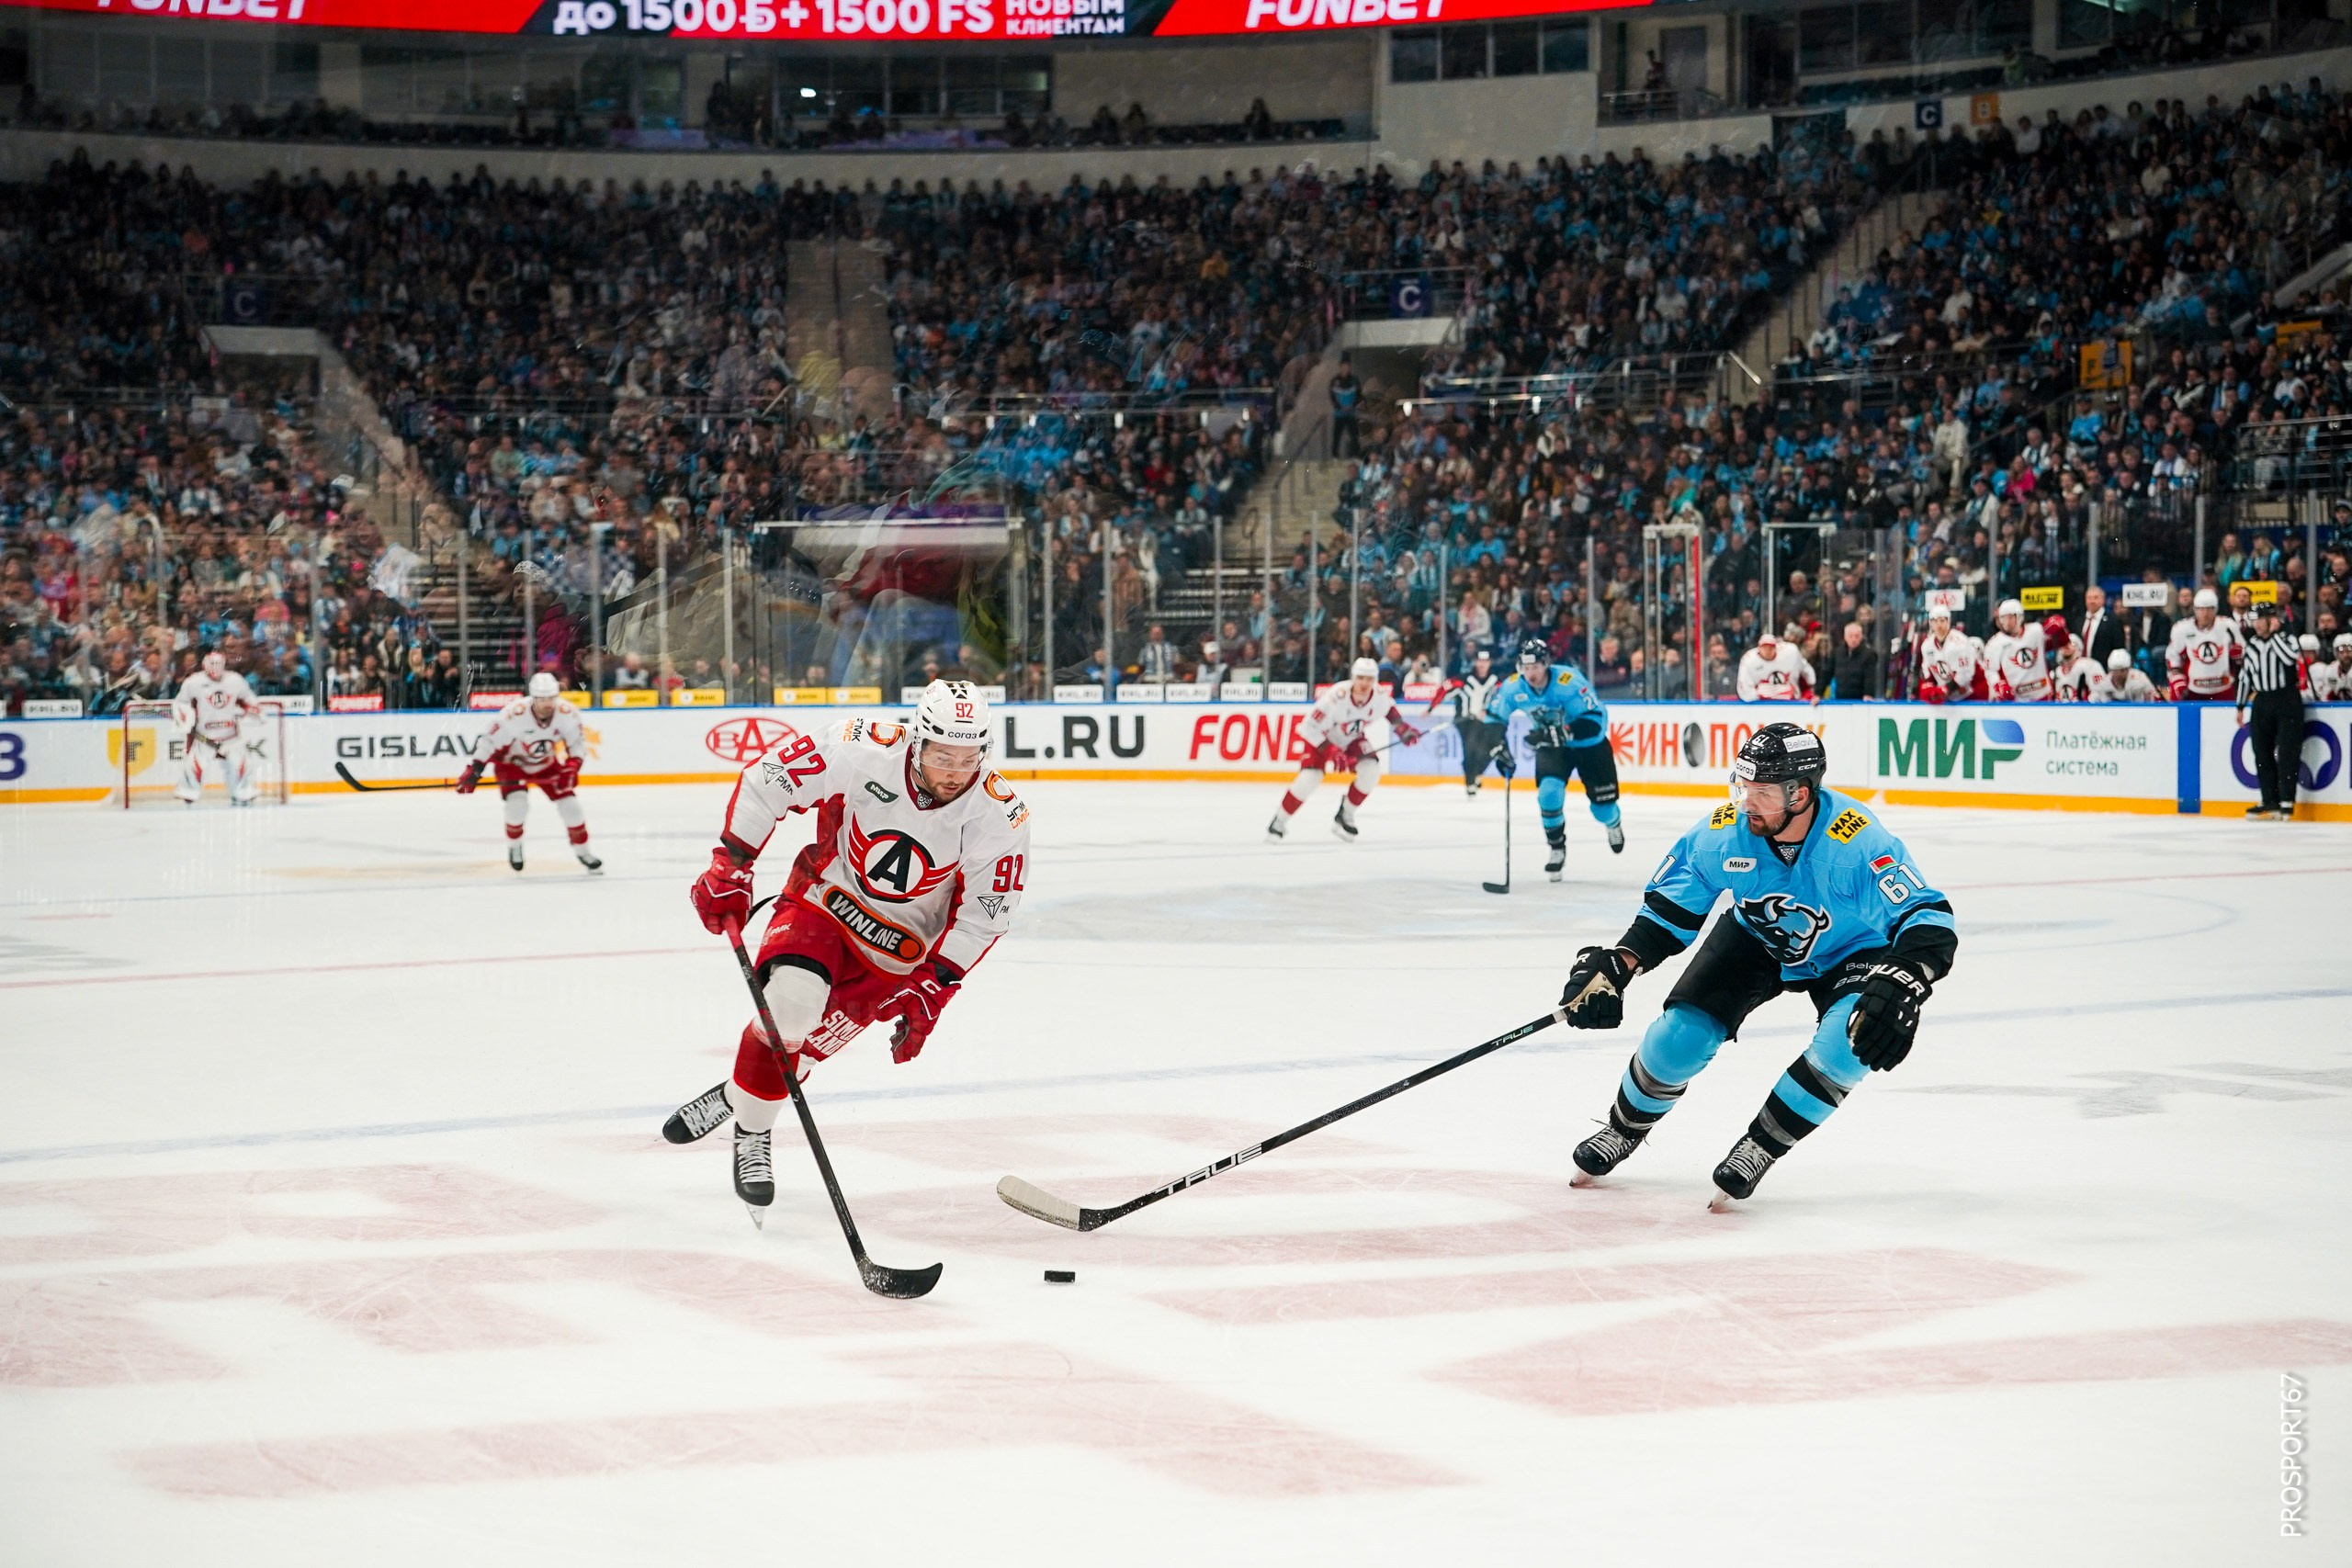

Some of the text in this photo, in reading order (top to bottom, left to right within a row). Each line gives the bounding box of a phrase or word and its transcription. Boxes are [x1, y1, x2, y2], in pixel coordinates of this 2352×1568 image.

[553, 1, 617, 36] до
[1006, 0, 1125, 17] НОВЫМ
[1006, 17, 1125, 36] КЛИЕНТАМ
[1920, 105, 1937, 125] C
[233, 292, 257, 318] C
[1398, 285, 1422, 312] C
[955, 702, 974, 718] 92
[947, 730, 978, 739] согаз
[1752, 734, 1770, 748] 61
[2046, 730, 2147, 751] Платёжная
[1879, 718, 2025, 780] МИР
[778, 735, 827, 788] 92
[2045, 761, 2119, 776] система
[870, 784, 889, 800] МИР
[1830, 810, 1857, 835] MAX
[1841, 816, 1868, 840] LINE
[866, 834, 913, 894] A
[992, 853, 1024, 891] 92
[1729, 861, 1750, 869] МИР
[1878, 863, 1927, 905] 61
[831, 894, 902, 952] WINLINE
[1491, 1024, 1533, 1046] TRUE
[1148, 1142, 1262, 1195] TRUE
